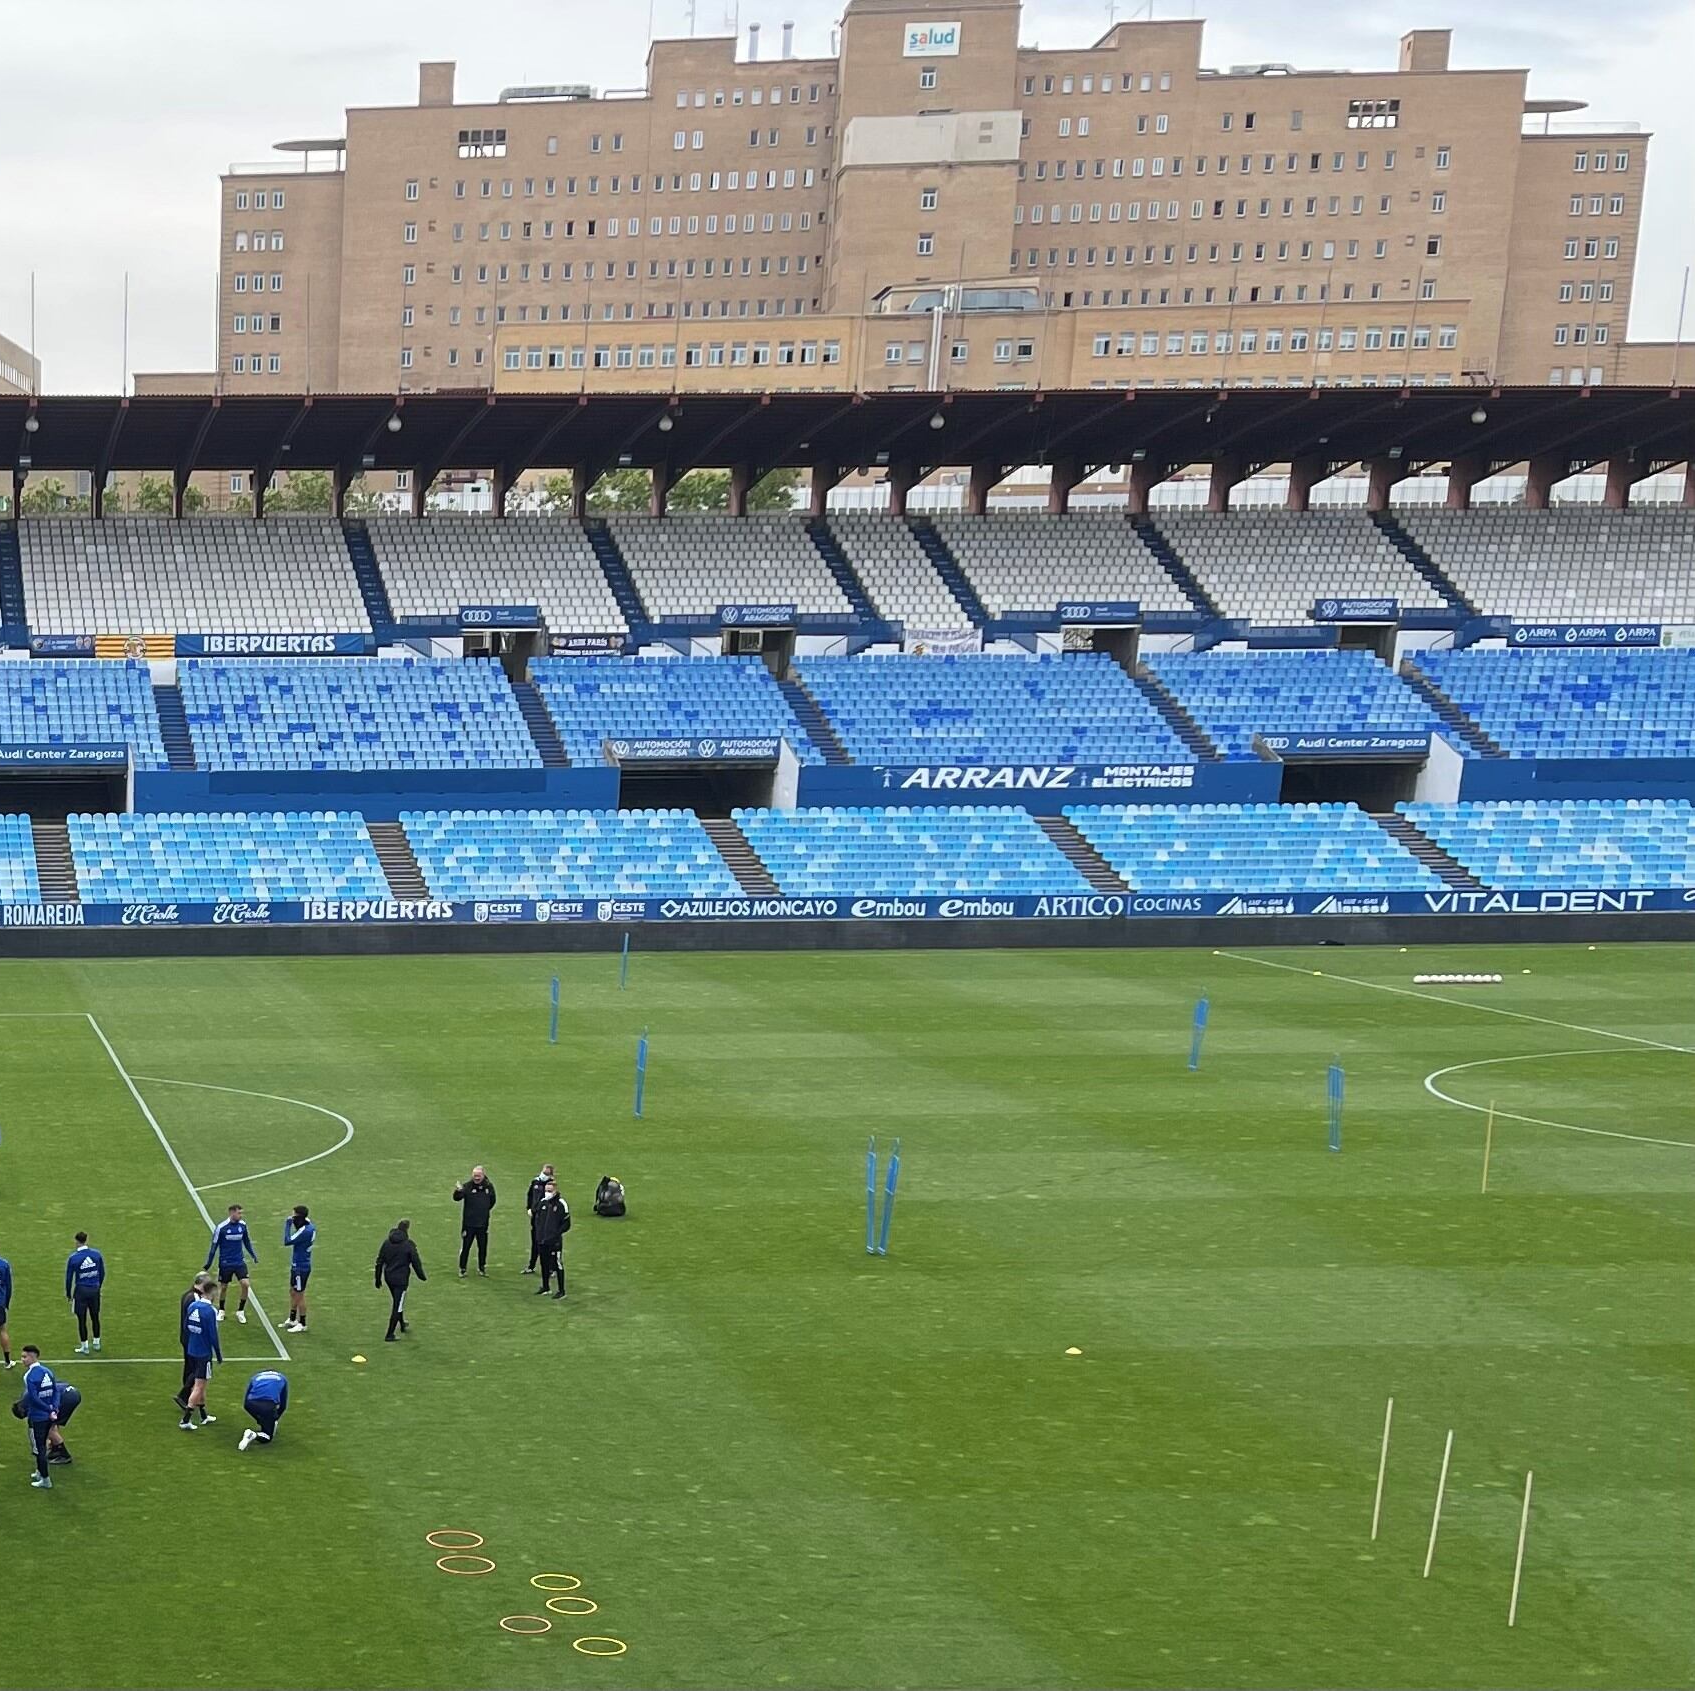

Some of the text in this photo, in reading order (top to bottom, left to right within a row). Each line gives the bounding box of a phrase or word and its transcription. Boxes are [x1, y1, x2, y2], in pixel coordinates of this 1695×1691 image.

[910, 27, 955, 45] salud
[742, 606, 793, 615] AUTOMOCIÓN
[1528, 627, 1558, 637] ARPA
[1578, 627, 1607, 637] ARPA
[1628, 627, 1657, 636] ARPA
[204, 636, 336, 652] IBERPUERTAS
[633, 739, 691, 749] AUTOMOCIÓN
[720, 738, 778, 748] AUTOMOCIÓN
[1297, 737, 1427, 749] Audi Center Zaragoza
[26, 749, 66, 759] Center
[68, 749, 124, 760] Zaragoza
[636, 748, 688, 757] ARAGONESA
[722, 748, 775, 756] ARAGONESA
[1104, 765, 1195, 776] MONTAJES
[901, 766, 1076, 788] ARRANZ
[612, 902, 646, 912] CESTE
[939, 897, 1015, 917] embou
[1033, 896, 1202, 916] ARTICO COCINAS
[1424, 890, 1655, 913] VITALDENT
[304, 901, 454, 921] IBERPUERTAS
[489, 903, 523, 913] CESTE
[551, 902, 584, 913] CESTE
[679, 900, 838, 916] AZULEJOS MONCAYO
[851, 898, 927, 918] embou
[3, 904, 85, 925] ROMAREDA
